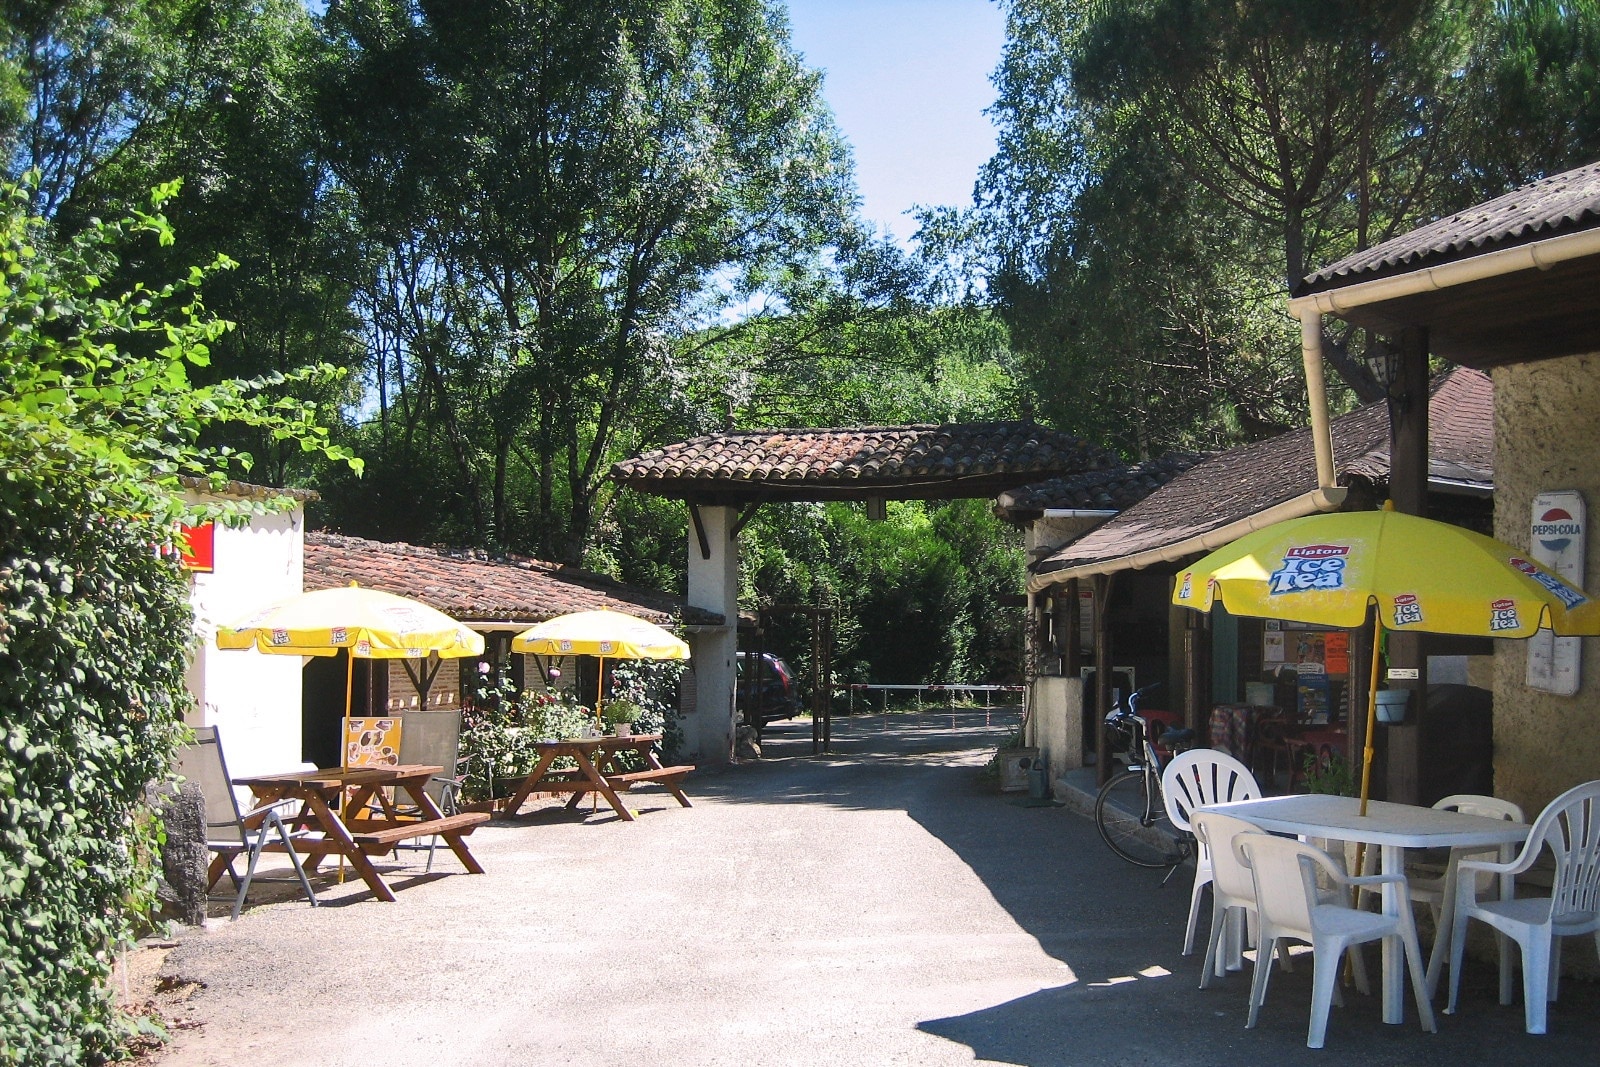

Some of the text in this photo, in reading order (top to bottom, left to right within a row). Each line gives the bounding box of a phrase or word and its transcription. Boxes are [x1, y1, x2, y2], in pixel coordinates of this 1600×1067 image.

[1532, 524, 1581, 535] PEPSI-COLA
[1292, 548, 1343, 556] Lipton
[1282, 558, 1343, 573] Ice
[1271, 571, 1341, 593] Tea
[1394, 603, 1419, 614] Ice
[1394, 612, 1421, 624] Tea
[1493, 609, 1515, 620] Ice
[1491, 618, 1518, 630] Tea
